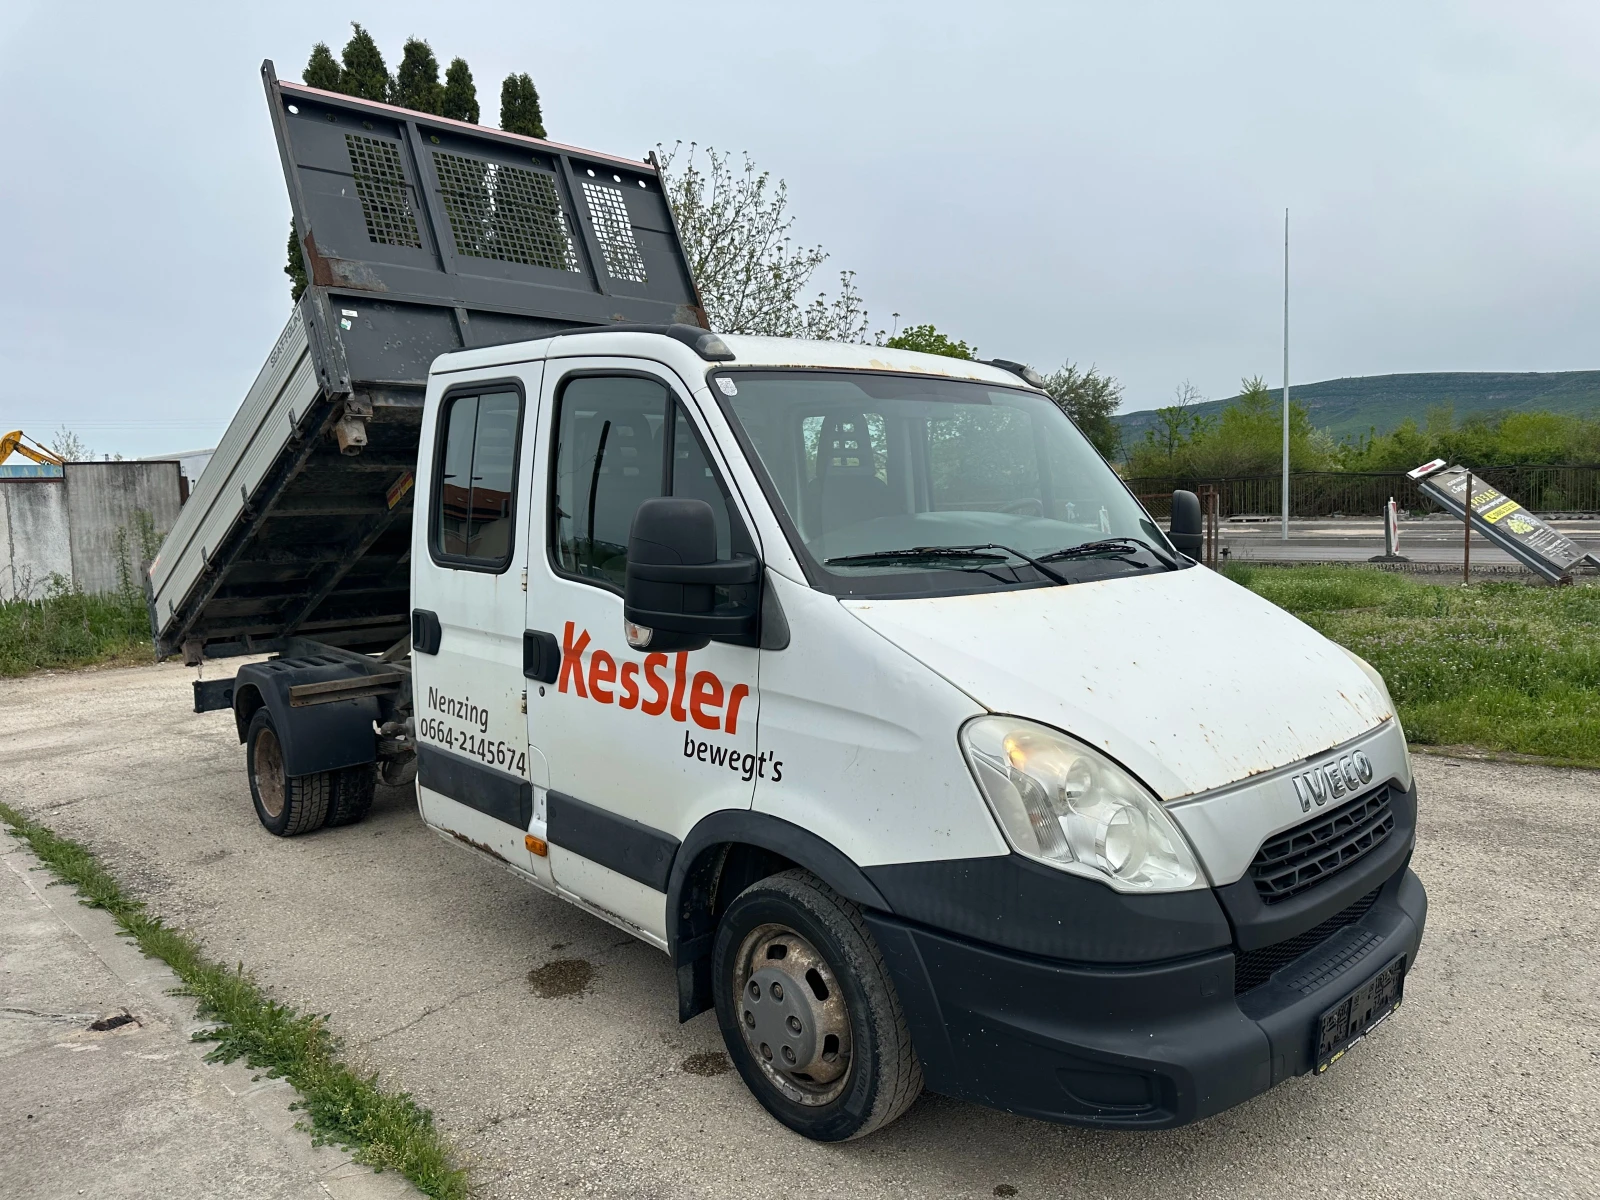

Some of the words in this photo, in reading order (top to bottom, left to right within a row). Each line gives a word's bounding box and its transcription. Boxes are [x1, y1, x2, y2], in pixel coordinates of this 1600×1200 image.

[428, 686, 489, 733] Nenzing
[420, 718, 527, 776] 0664-2145674
[684, 730, 783, 782] bewegt's
[1292, 750, 1373, 813] IVECO
